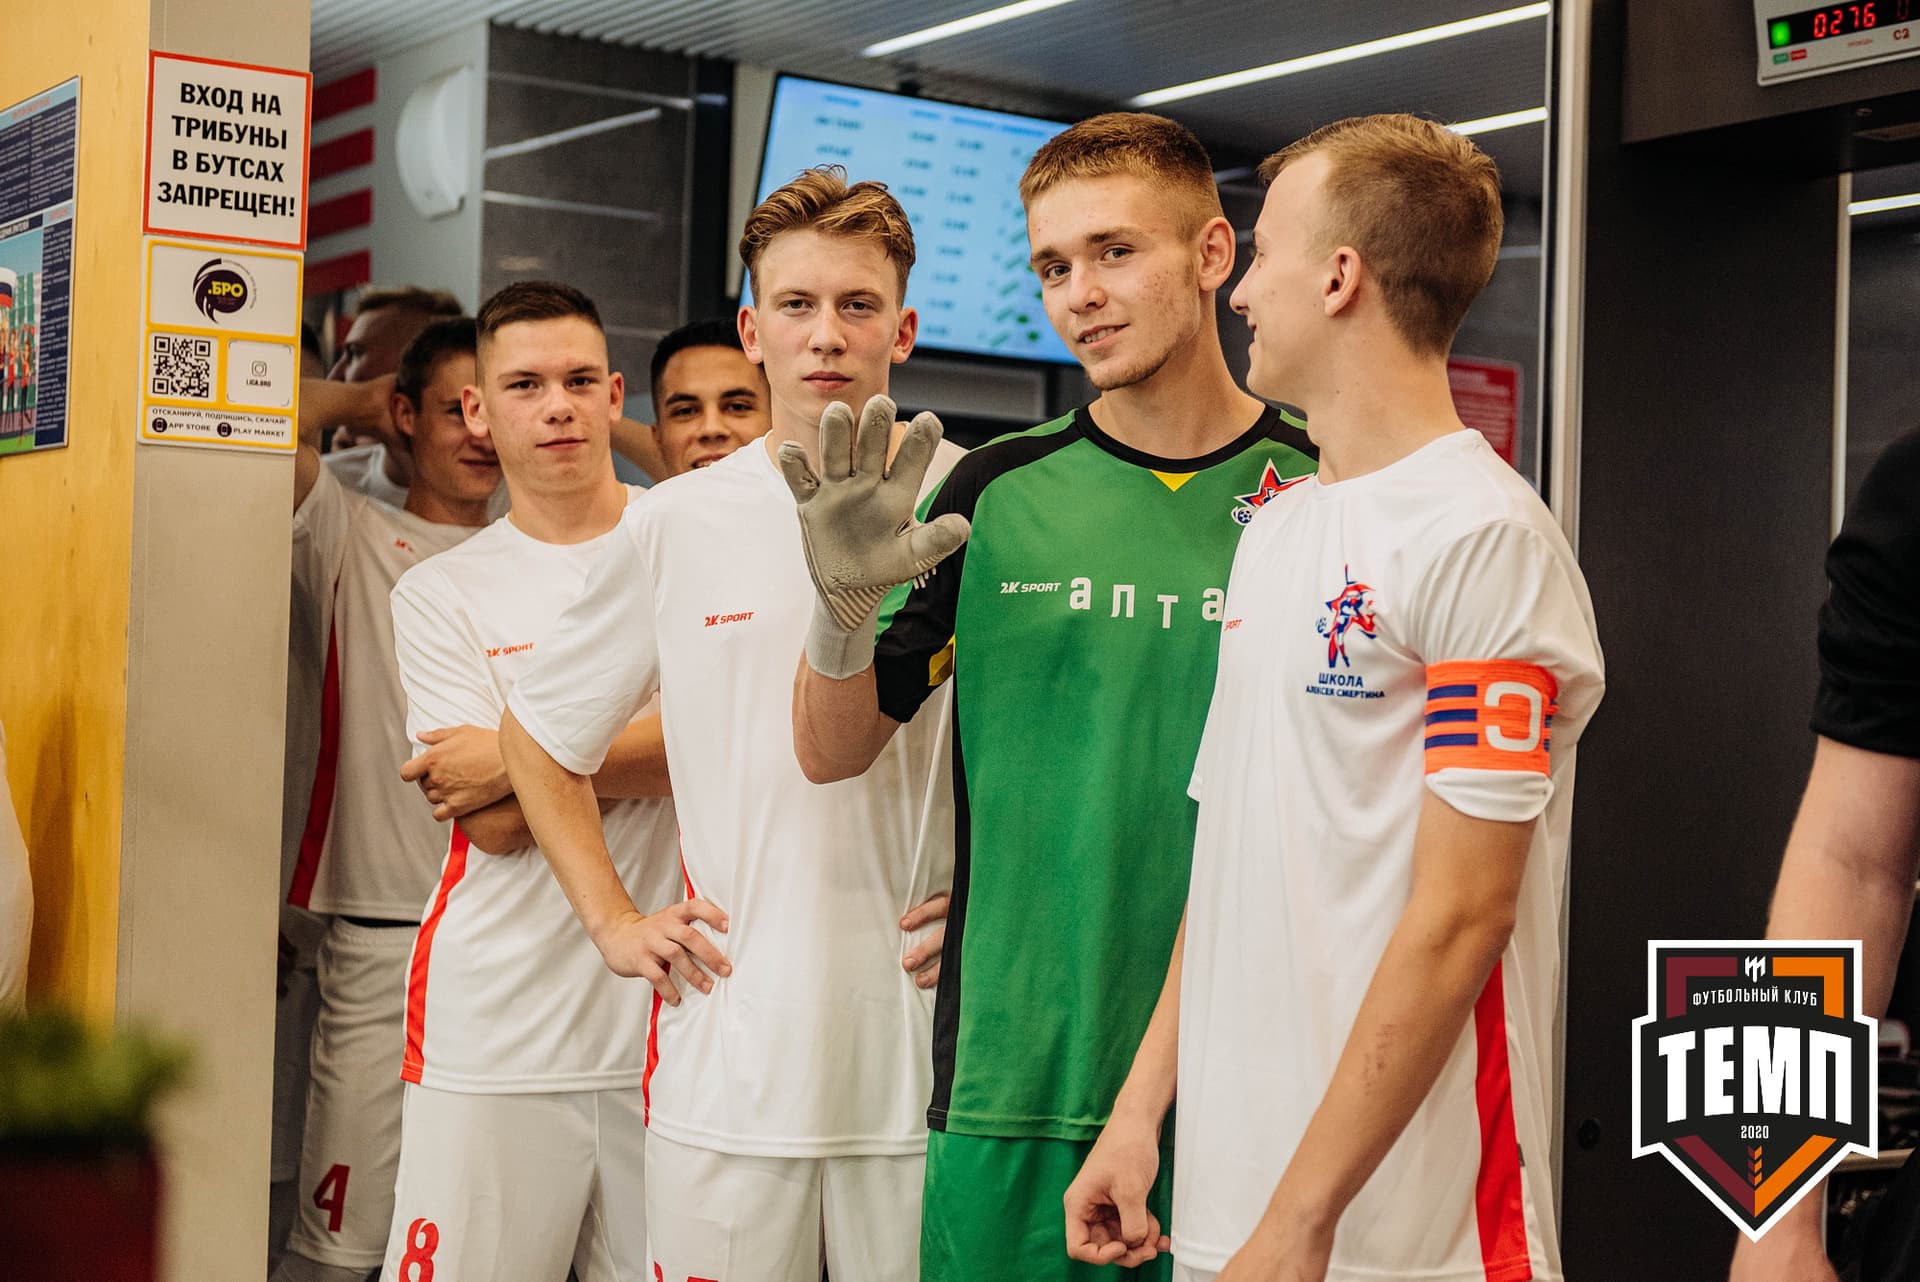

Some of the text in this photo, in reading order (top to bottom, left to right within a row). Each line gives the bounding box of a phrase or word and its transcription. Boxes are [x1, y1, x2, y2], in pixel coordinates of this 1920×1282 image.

[1813, 2, 1877, 39] 0276
[180, 82, 282, 116] ВХОД НА
[171, 115, 287, 149] ТРИБУНЫ
[172, 149, 284, 183] В БУТСАХ
[157, 181, 295, 218] ЗАПРЕЩЕН!
[207, 280, 244, 298] .БРО
[152, 407, 203, 419] ОТСКАНИРУЙ,
[168, 421, 211, 431] APP STORE
[233, 427, 285, 438] PLAY MARKET
[1020, 582, 1062, 593] SPORT
[720, 611, 754, 624] SPORT
[1318, 672, 1364, 688] ШКОЛА
[313, 1163, 351, 1232] 4
[400, 1217, 440, 1282] 8
